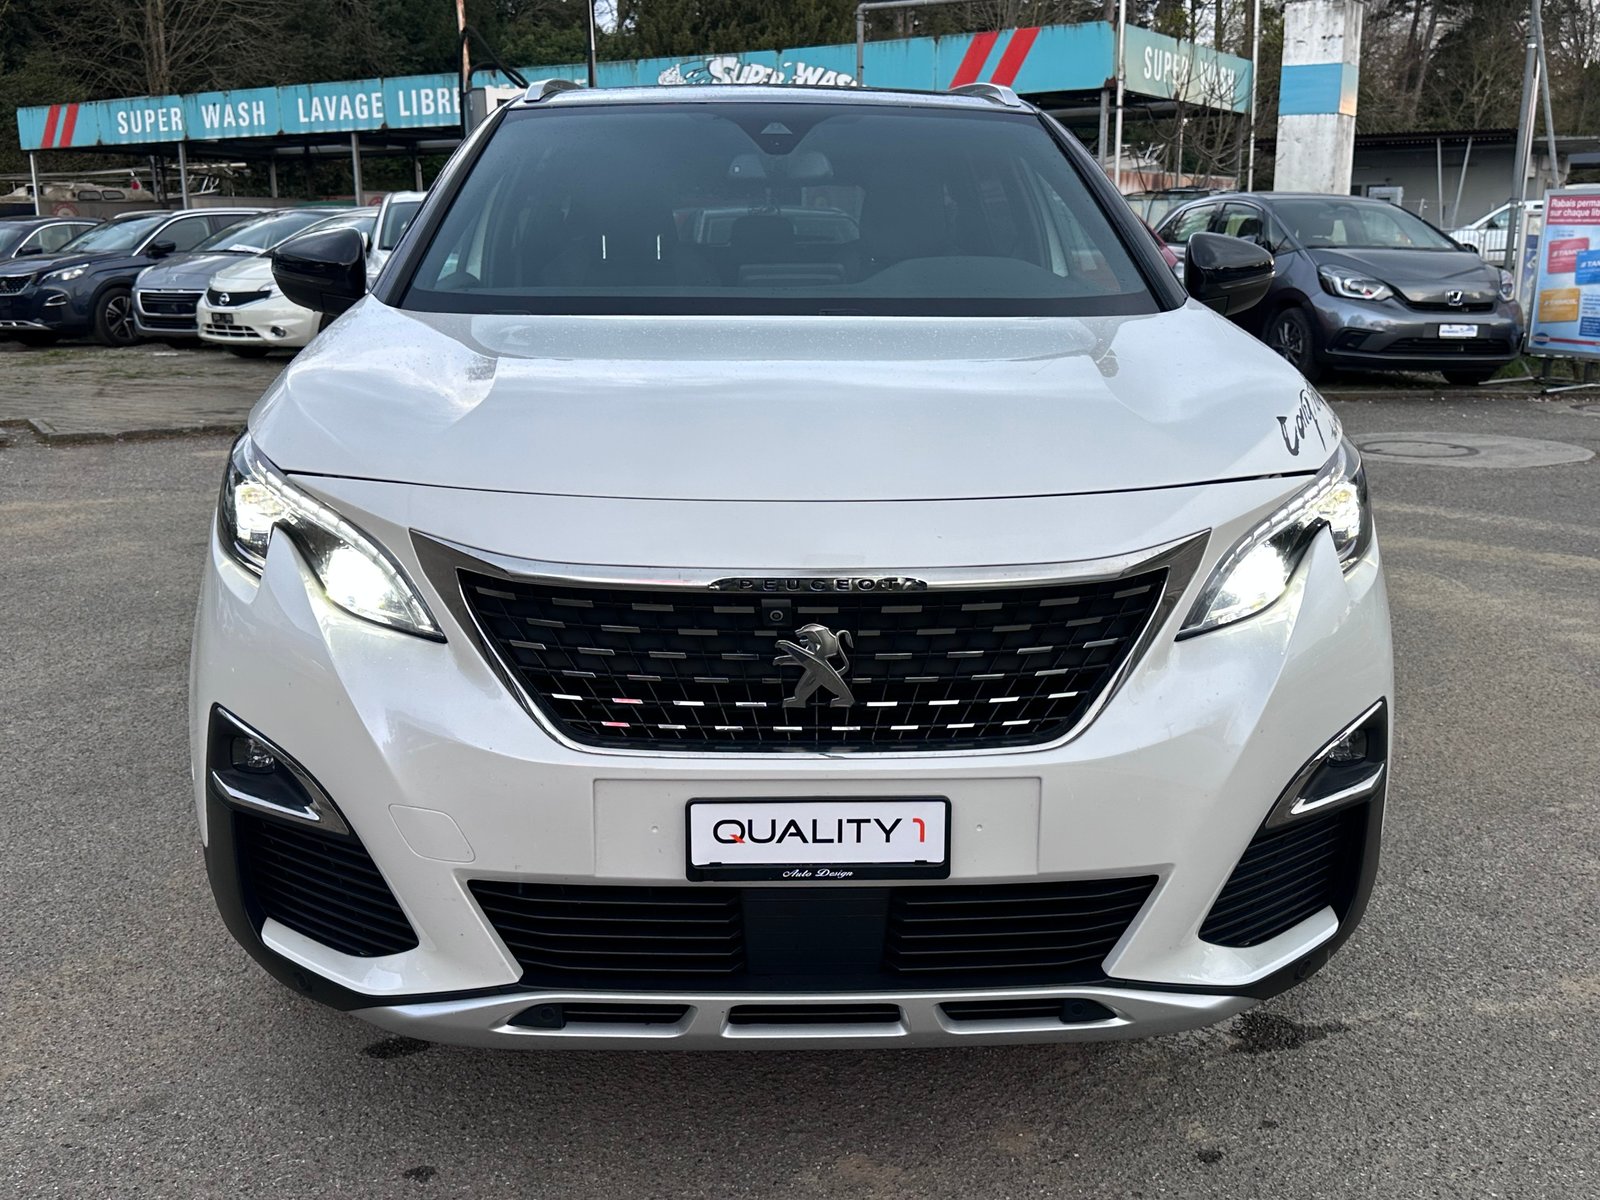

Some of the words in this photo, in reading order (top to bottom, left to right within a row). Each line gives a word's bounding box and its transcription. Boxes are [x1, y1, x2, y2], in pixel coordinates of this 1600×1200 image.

[795, 62, 866, 87] WAS
[1143, 46, 1189, 87] SUPER
[117, 107, 183, 135] SUPER
[201, 100, 266, 129] WASH
[298, 92, 384, 123] LAVAGE
[738, 578, 900, 592] PEUGEOT
[713, 818, 903, 844] QUALITY
[782, 869, 812, 878] Auto
[815, 868, 854, 879] Design
